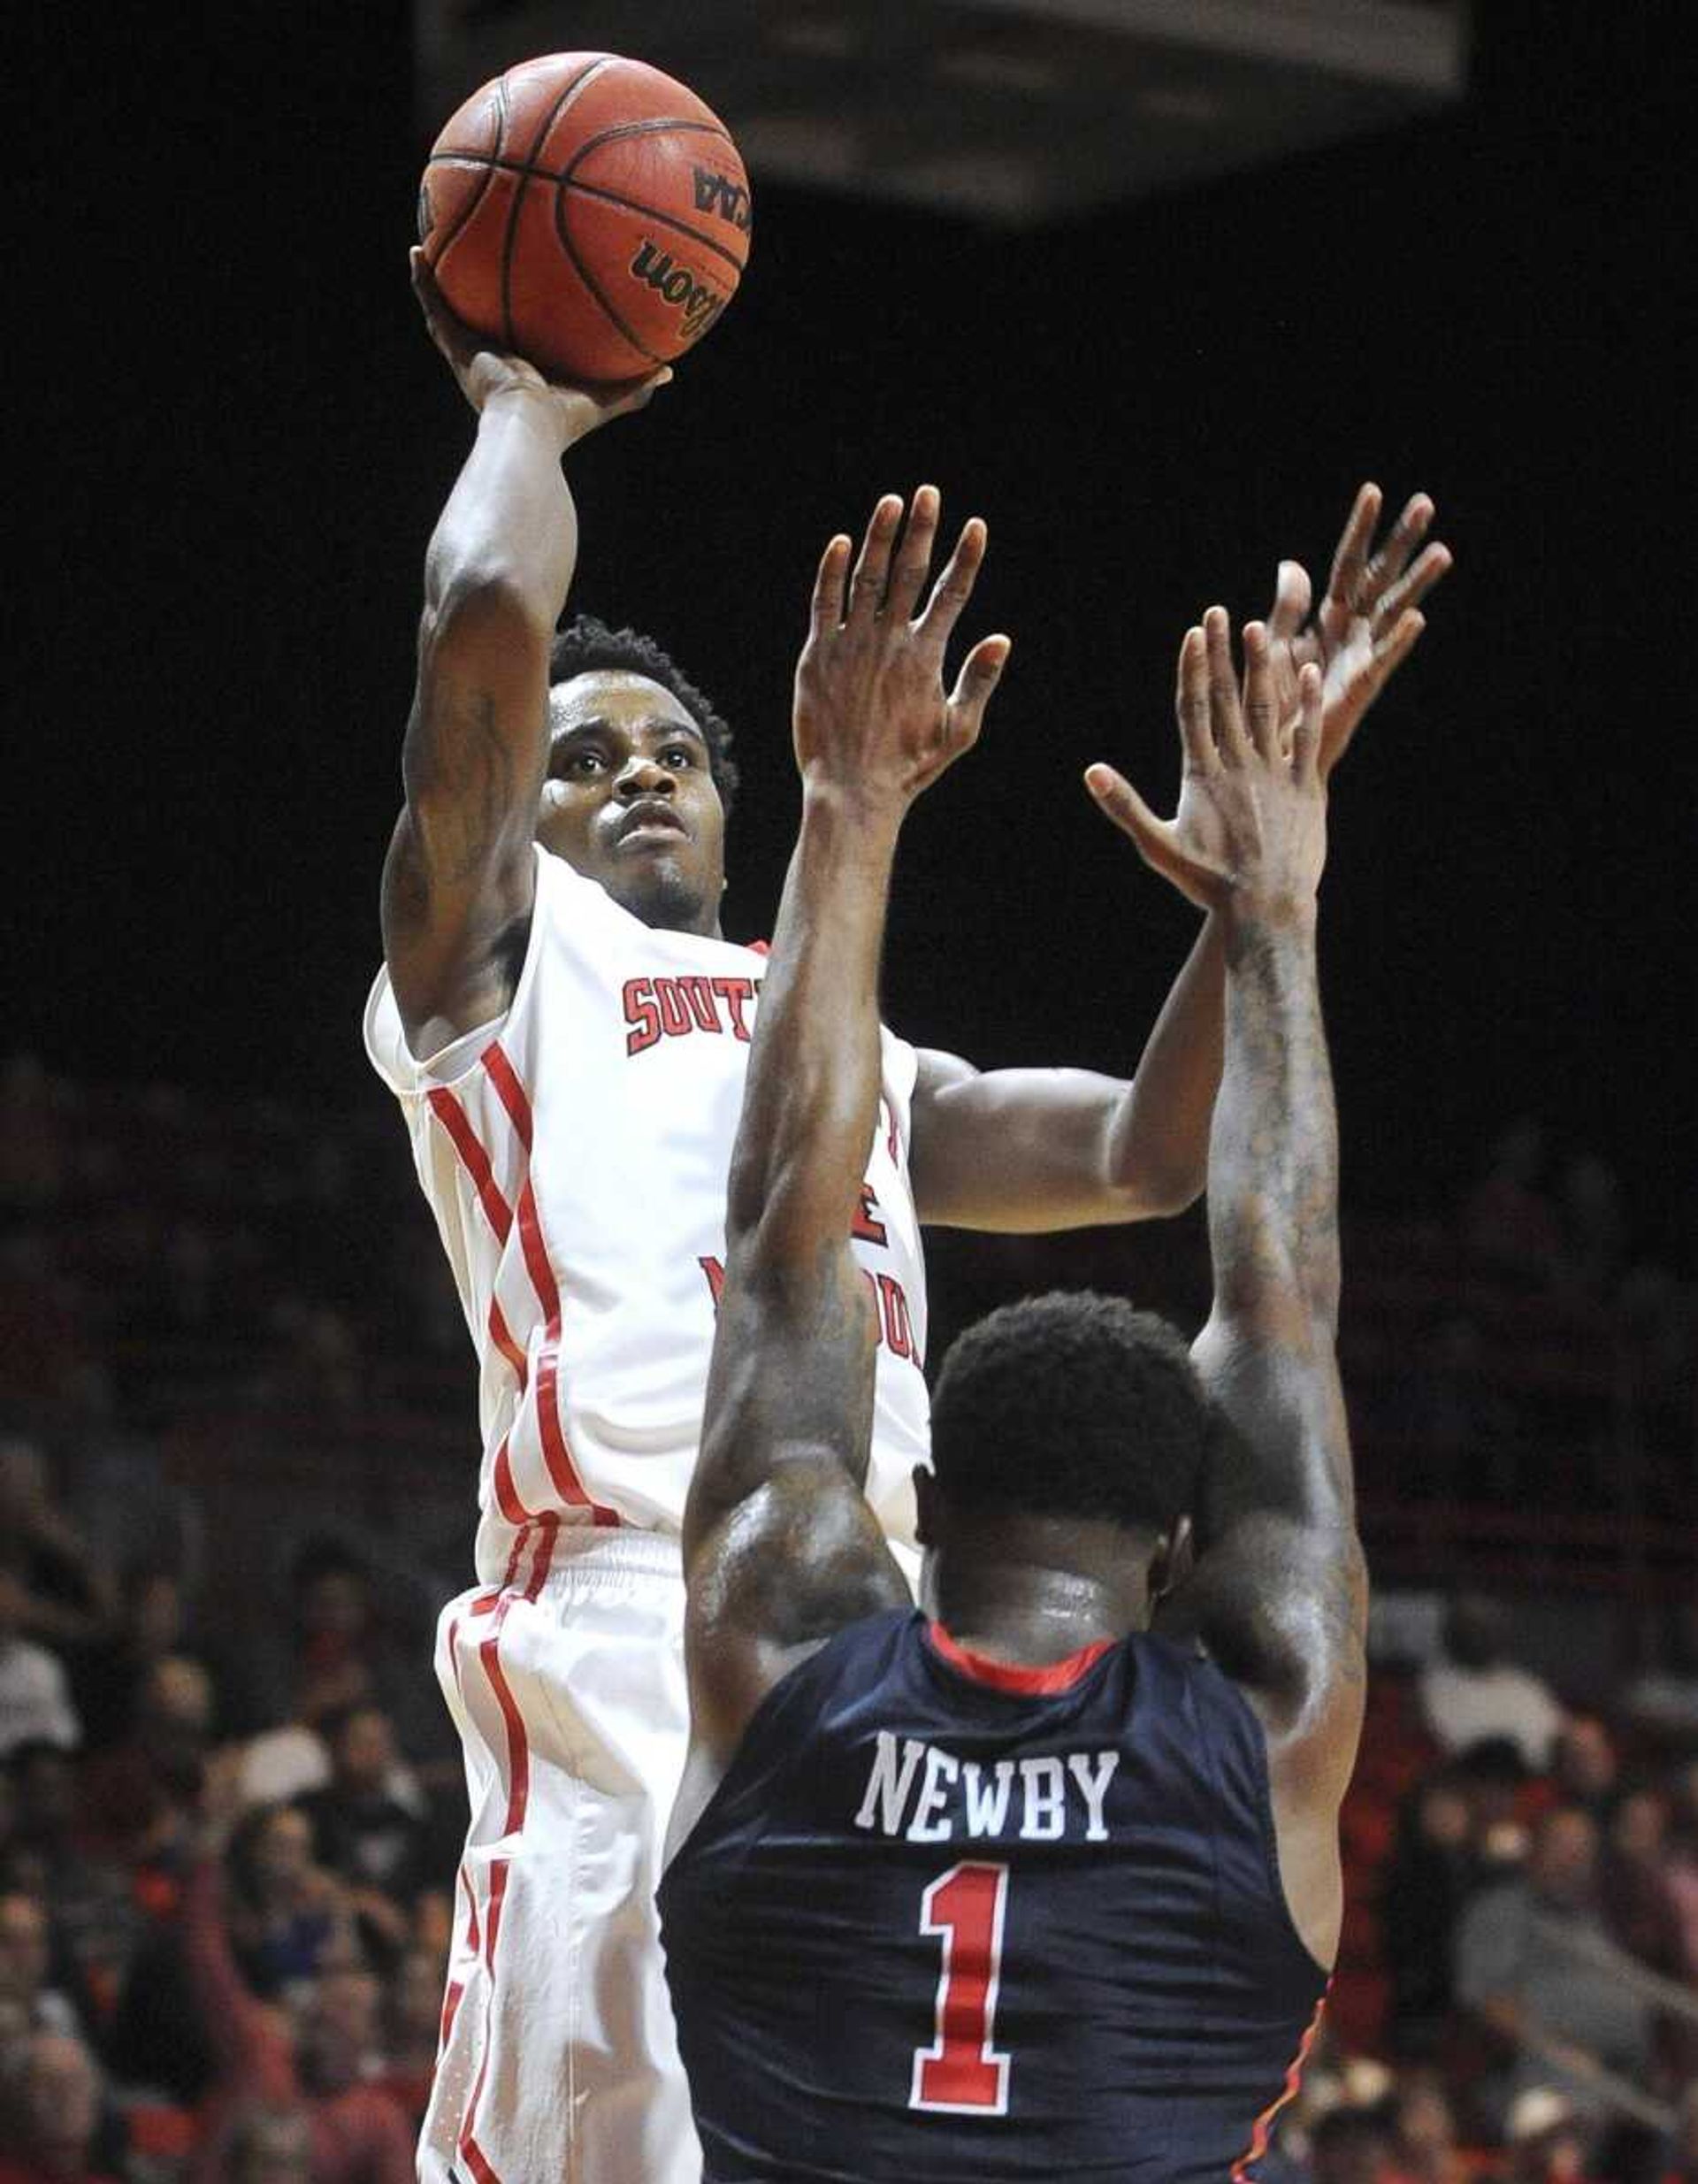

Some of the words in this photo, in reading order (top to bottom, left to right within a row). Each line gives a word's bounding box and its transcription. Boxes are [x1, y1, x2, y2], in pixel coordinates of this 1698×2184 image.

[693, 165, 752, 230] CAA
[623, 977, 762, 1058] SOUT
[854, 1731, 1120, 1842] NEWBY
[908, 1858, 1011, 2116] 1
